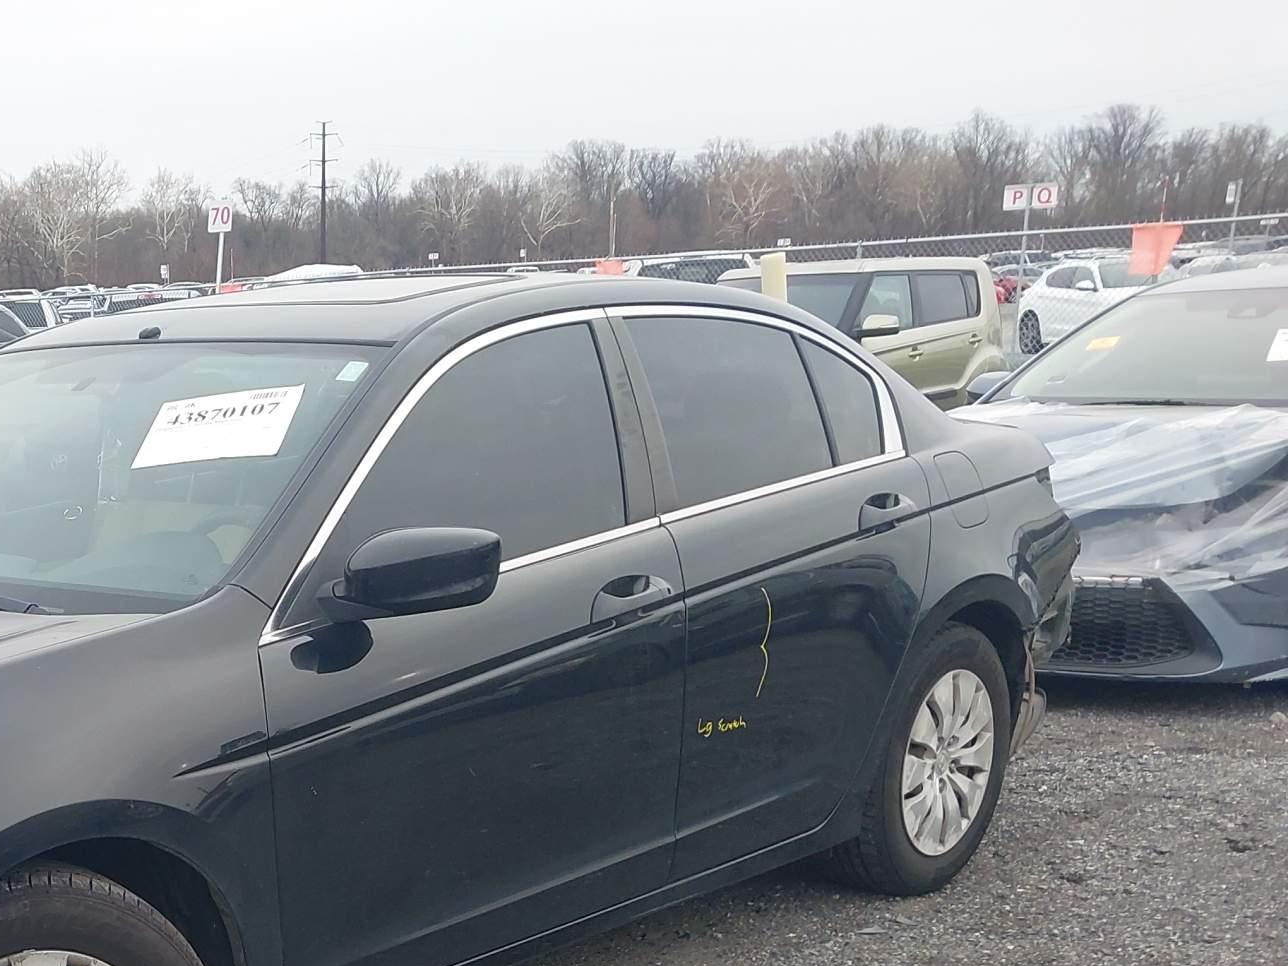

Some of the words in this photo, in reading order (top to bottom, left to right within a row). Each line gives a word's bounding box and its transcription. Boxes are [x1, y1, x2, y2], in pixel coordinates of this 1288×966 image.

[1012, 190, 1024, 206] P
[1037, 187, 1053, 204] Q
[211, 206, 231, 225] 70
[167, 401, 282, 426] 43870107
